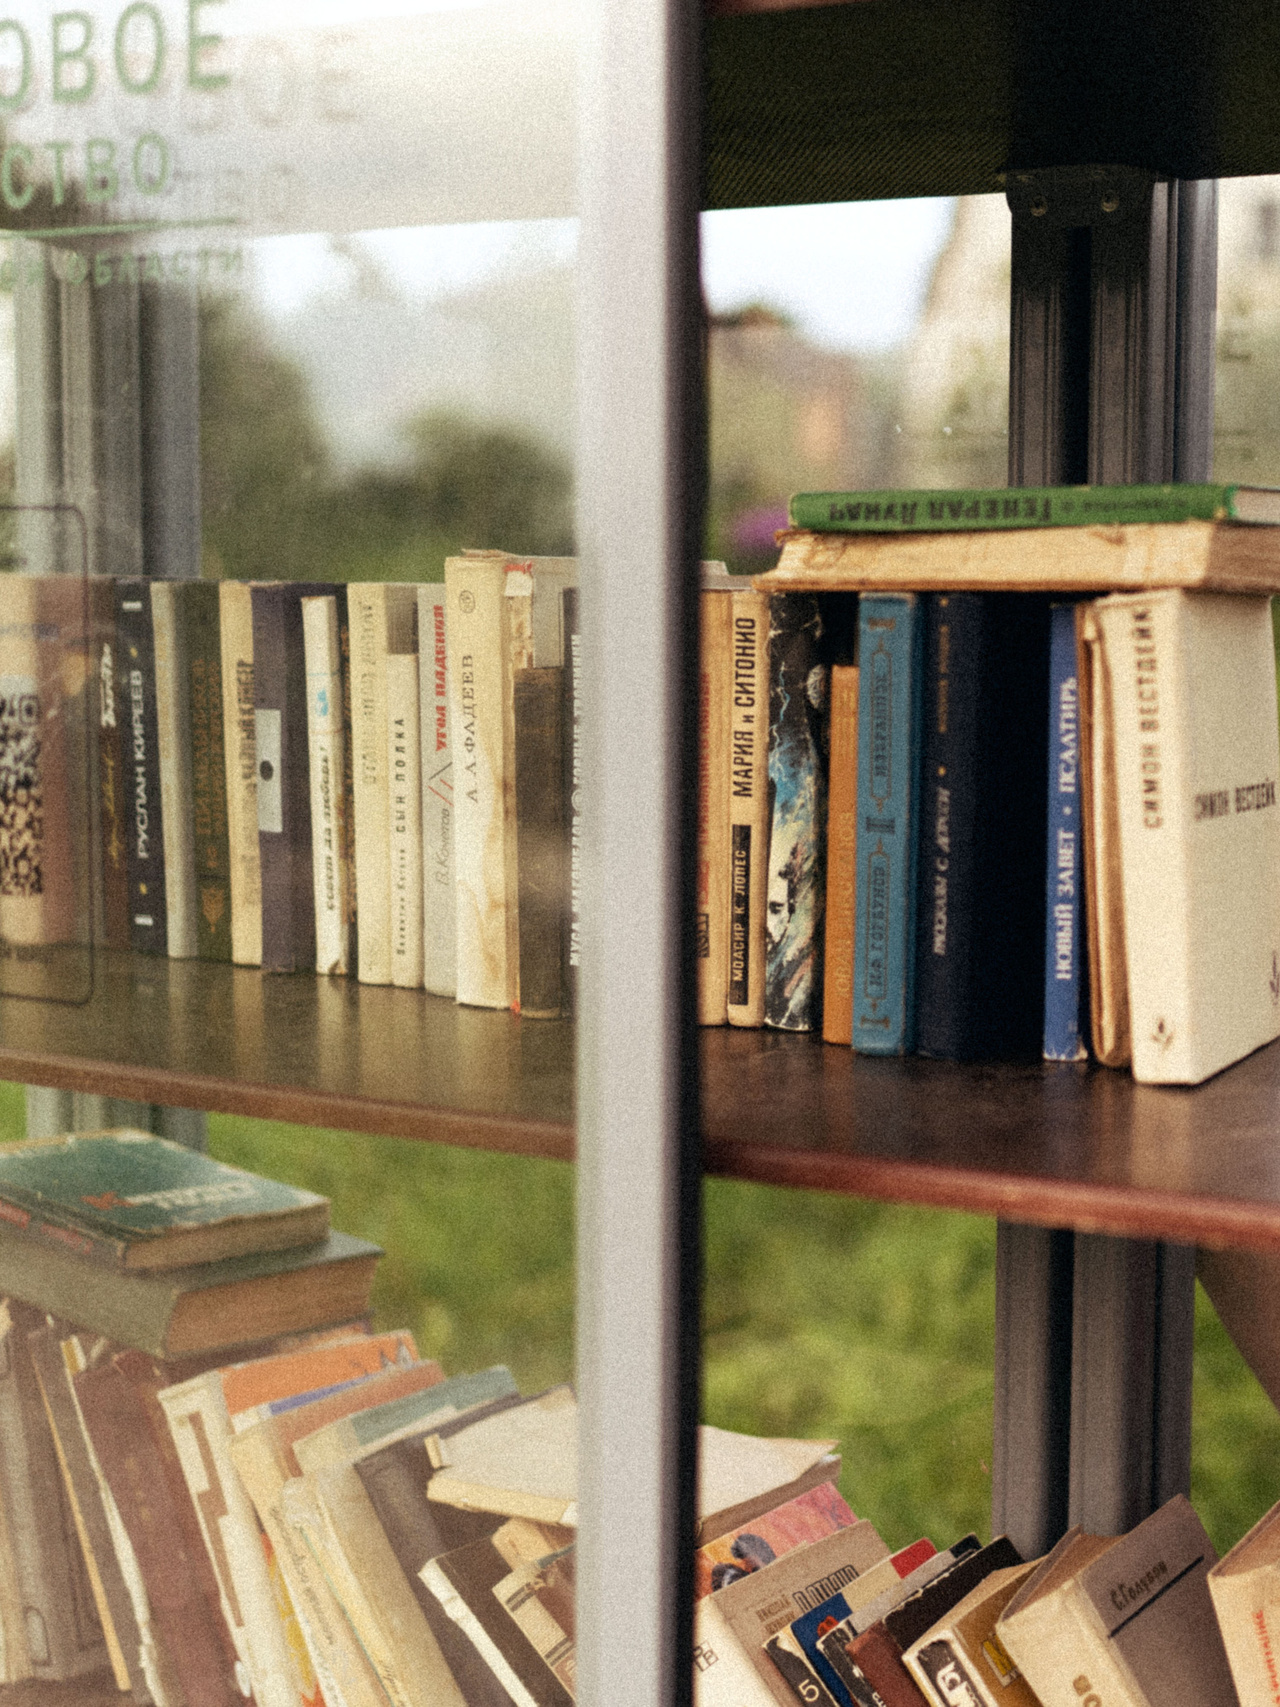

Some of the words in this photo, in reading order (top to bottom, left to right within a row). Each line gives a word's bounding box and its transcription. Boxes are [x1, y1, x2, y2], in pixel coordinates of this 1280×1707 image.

[433, 604, 446, 697] ПАДЕНИЯ
[734, 617, 756, 708] СИТОНИО
[1133, 608, 1160, 733] ВЕСТДЕЙК
[132, 669, 145, 762] КИРЕЕВ
[435, 705, 448, 752] УГОЛ
[463, 654, 475, 753] ФАДЕЕВ
[1059, 677, 1079, 793] ПСАЛТИРЬ
[395, 716, 405, 783] ПОЛКА
[733, 731, 755, 798] МАРИЯ
[1142, 743, 1163, 830] СИМОН
[136, 767, 150, 859] РУСЛАН
[396, 795, 406, 834] СЫН
[733, 848, 747, 897] ЛОПЕС
[1059, 828, 1076, 897] ЗАВЕТ
[733, 922, 746, 981] МОАСИР
[1056, 903, 1075, 981] НОВЫЙ
